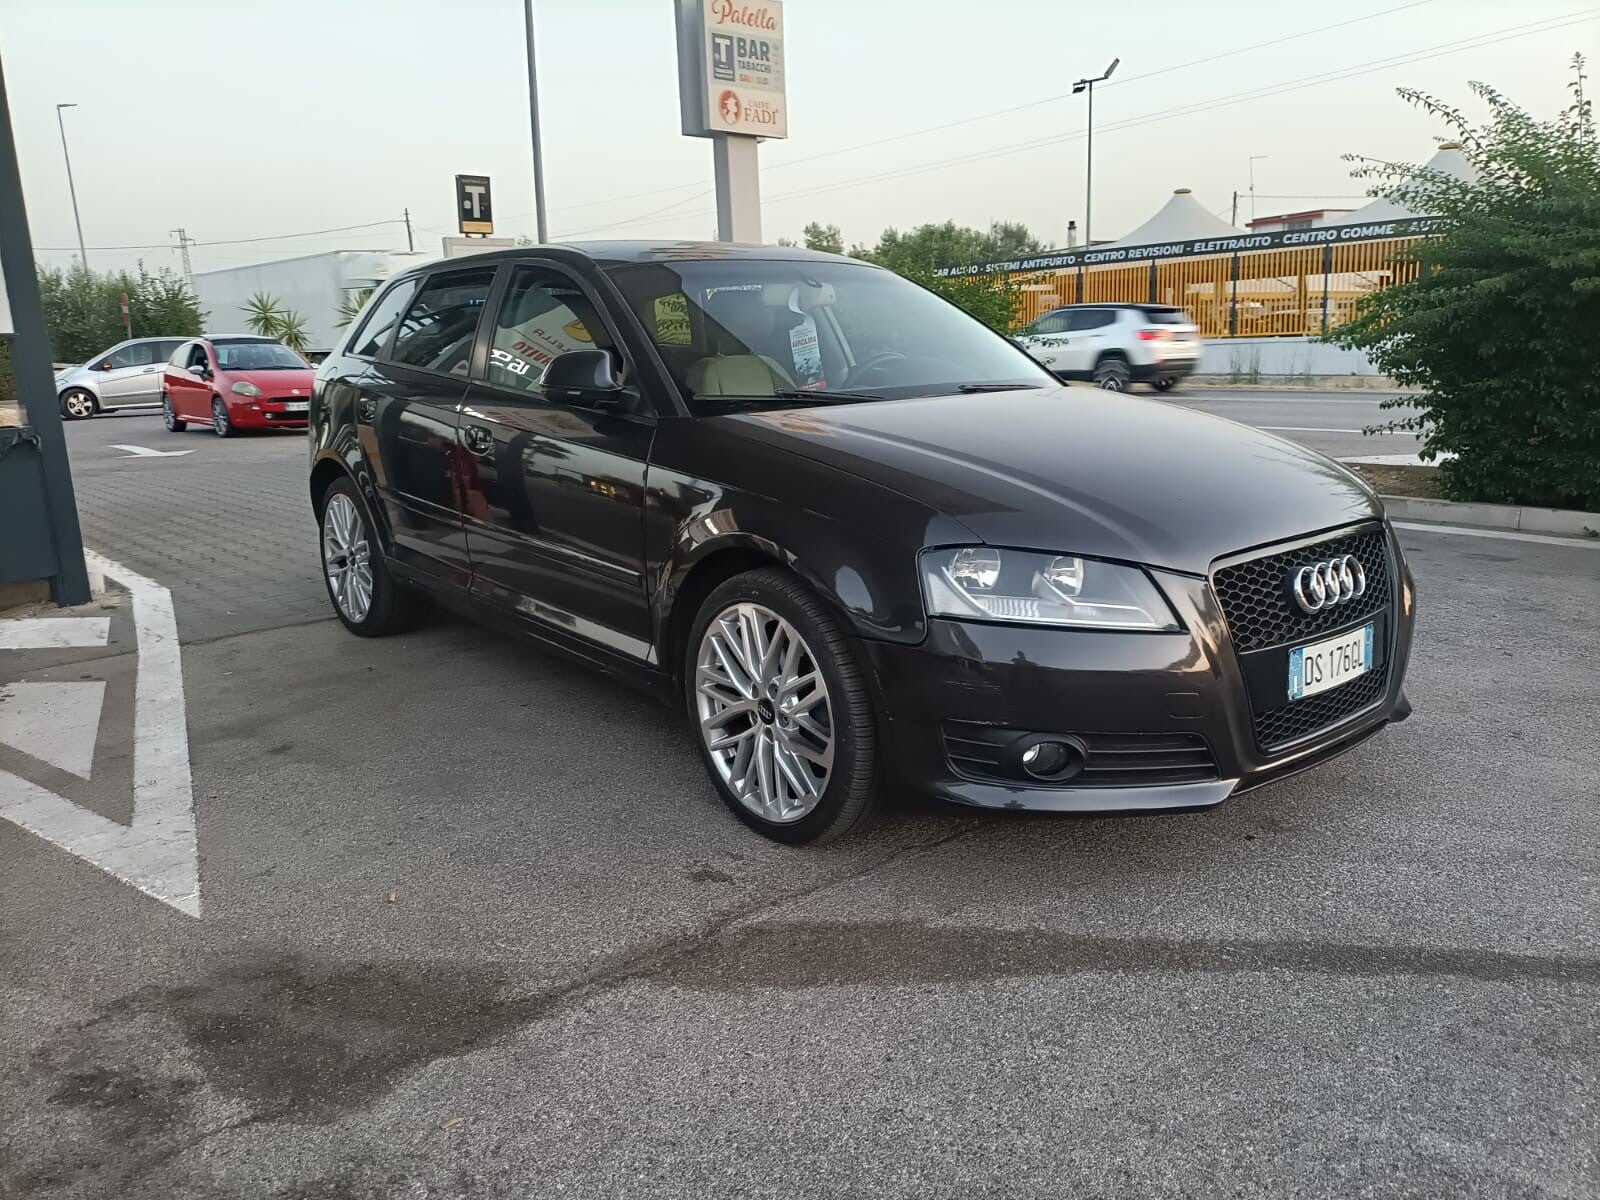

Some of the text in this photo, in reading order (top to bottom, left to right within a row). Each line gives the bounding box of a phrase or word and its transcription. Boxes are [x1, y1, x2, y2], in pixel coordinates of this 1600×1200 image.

[737, 36, 770, 63] BAR
[737, 60, 771, 73] TABACCHI
[464, 185, 486, 218] T
[1021, 255, 1076, 270] ANTIFURTO
[1084, 246, 1126, 264] CENTRO
[1128, 244, 1184, 259] REVISIONI
[1193, 235, 1271, 253] ELETTRAUTO
[1284, 228, 1338, 245] CENTRO
[1340, 223, 1395, 239] GOMME
[1304, 652, 1323, 686] DS
